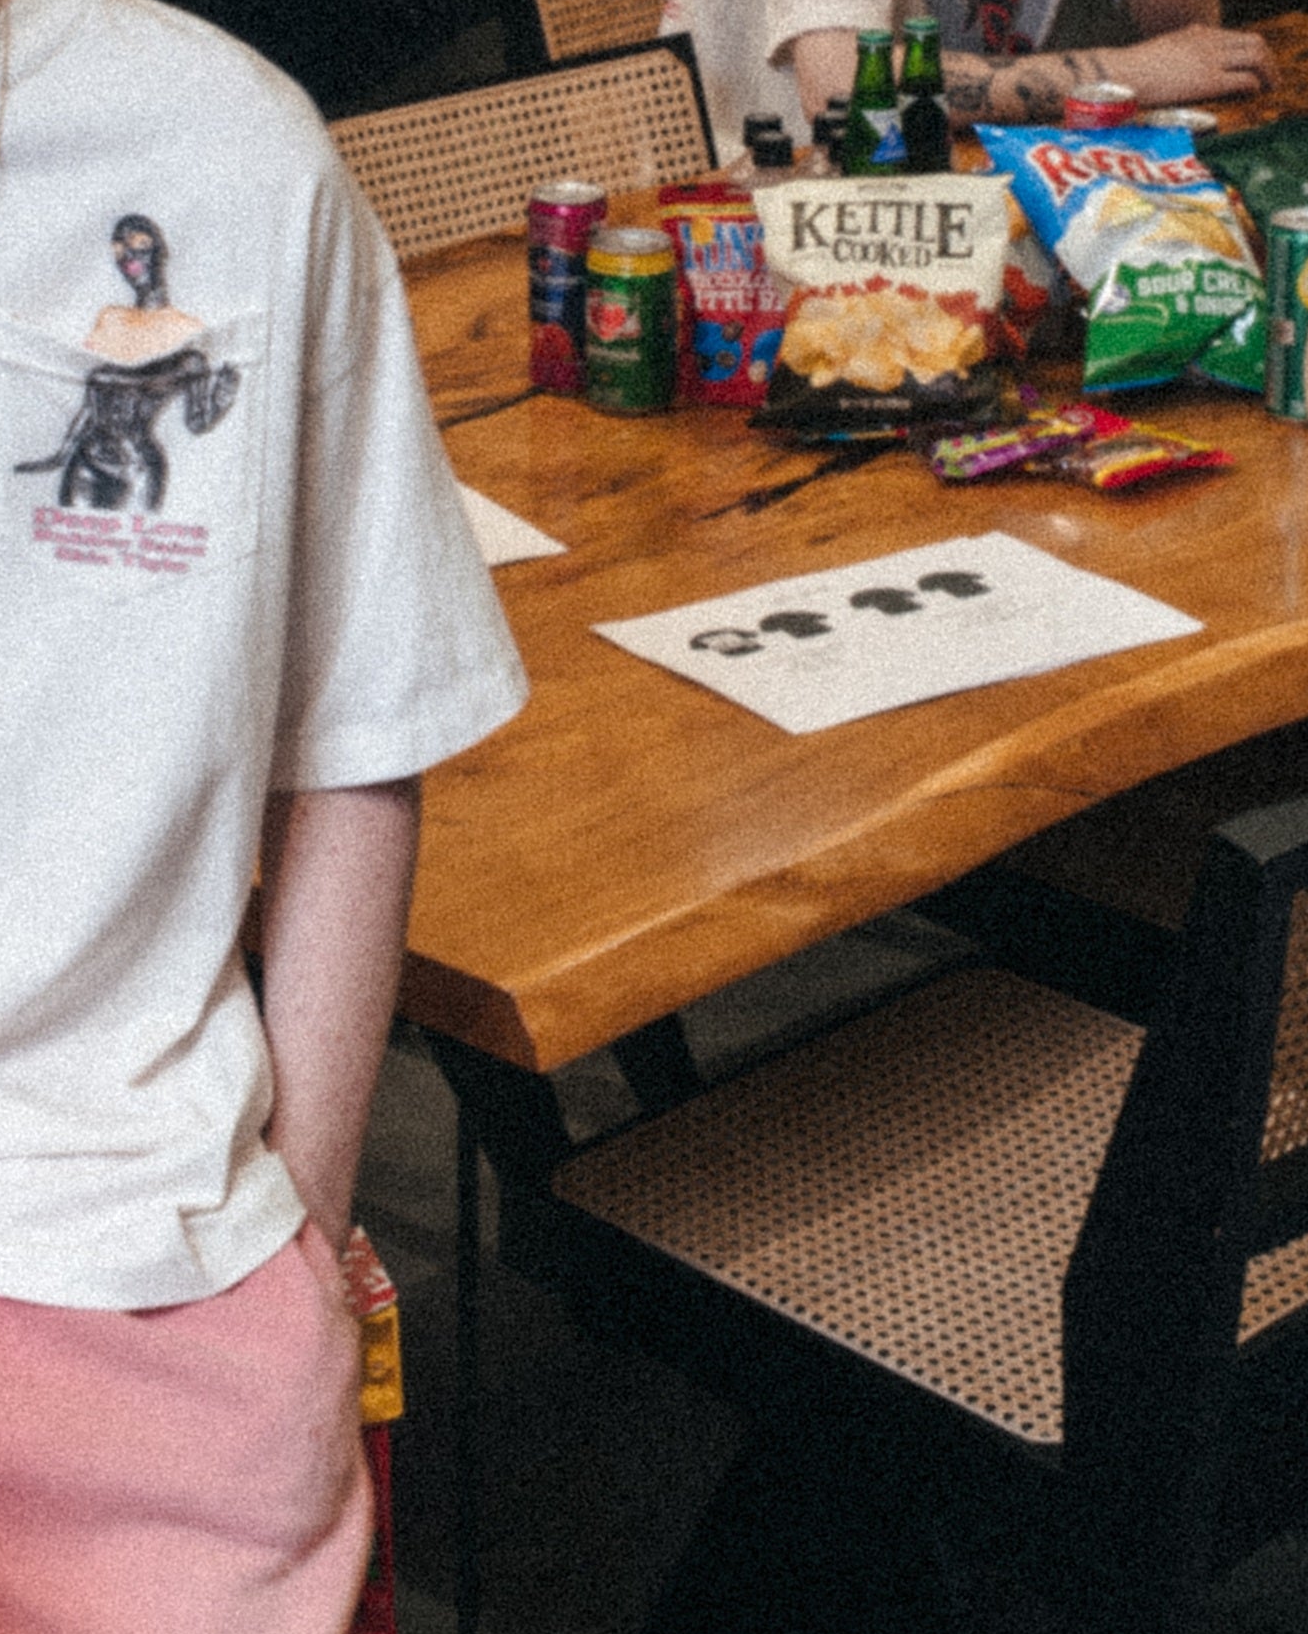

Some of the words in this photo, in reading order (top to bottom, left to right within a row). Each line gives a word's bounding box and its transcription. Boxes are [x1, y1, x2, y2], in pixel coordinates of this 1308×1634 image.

[790, 200, 974, 259] KETTLE
[832, 239, 935, 268] COOKED
[1137, 271, 1195, 298] SOUR
